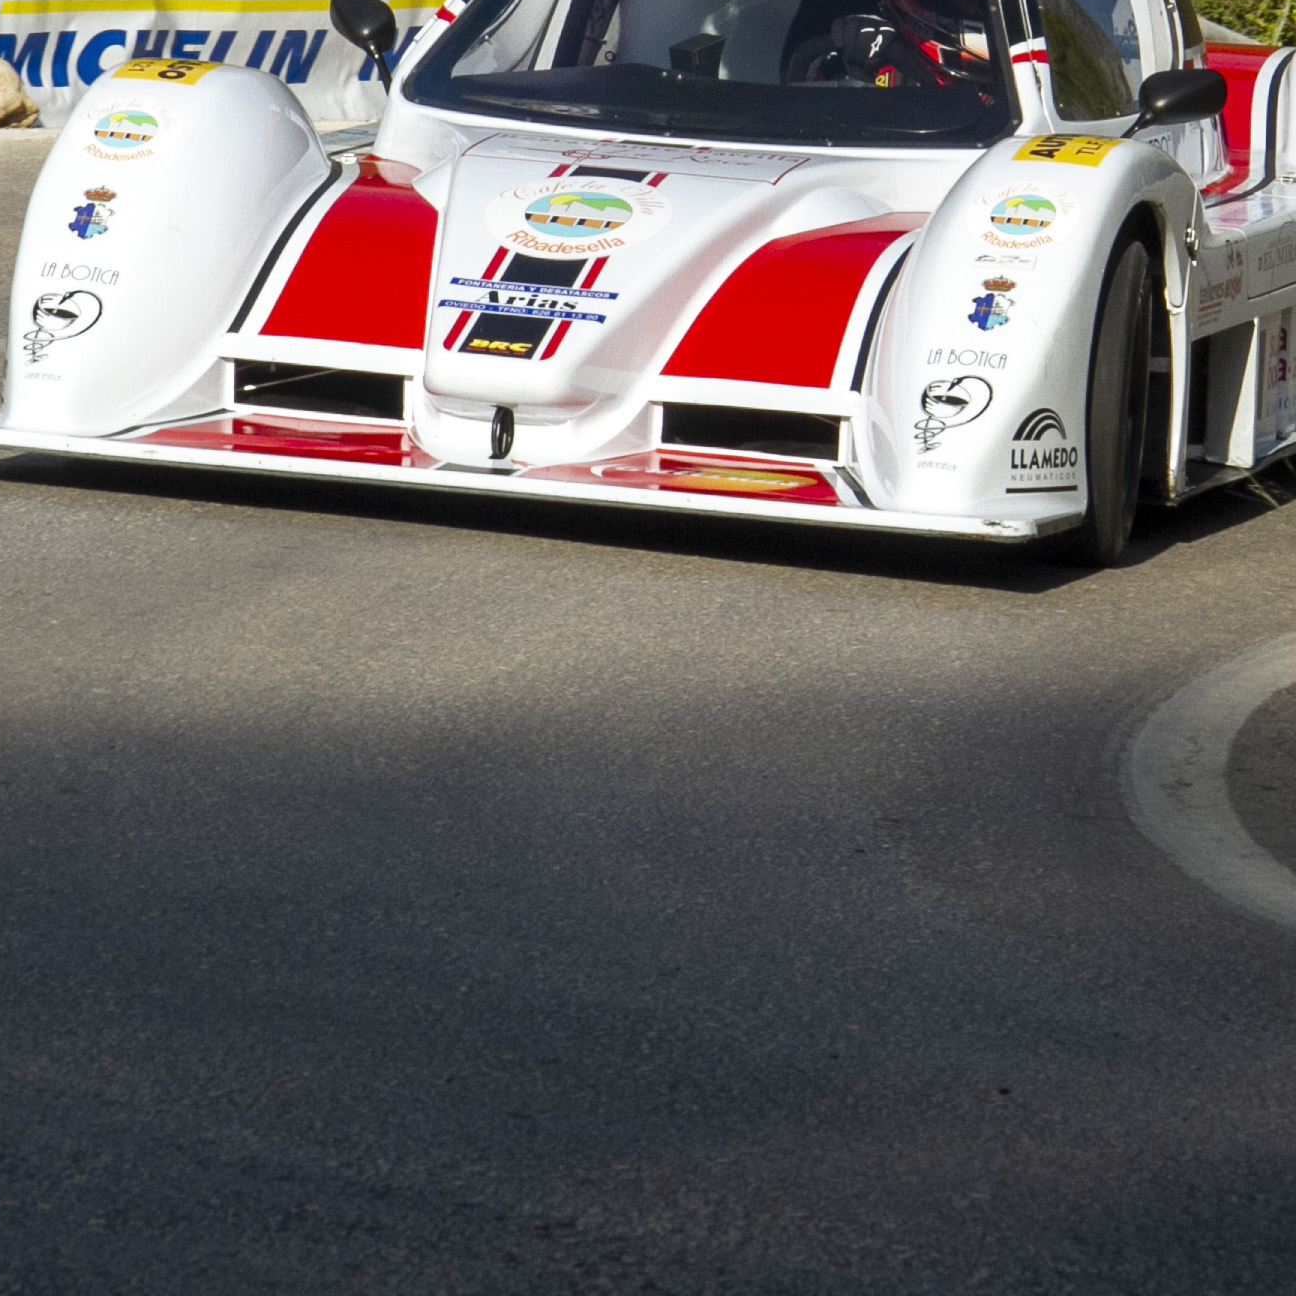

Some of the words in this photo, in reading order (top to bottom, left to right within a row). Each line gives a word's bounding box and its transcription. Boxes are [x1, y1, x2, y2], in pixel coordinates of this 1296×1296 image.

[83, 143, 154, 161] Ribadesella
[505, 229, 626, 254] Ribadesella
[980, 230, 1054, 250] Ribadesella
[41, 262, 57, 277] LA
[61, 264, 119, 285] BOTICA
[444, 300, 486, 310] OVIEDO
[474, 290, 579, 310] Arias
[927, 348, 943, 365] LA
[947, 349, 1008, 369] BOTICA
[1011, 446, 1078, 469] LLAMEDO
[1011, 472, 1077, 482] NEUMATICOS
